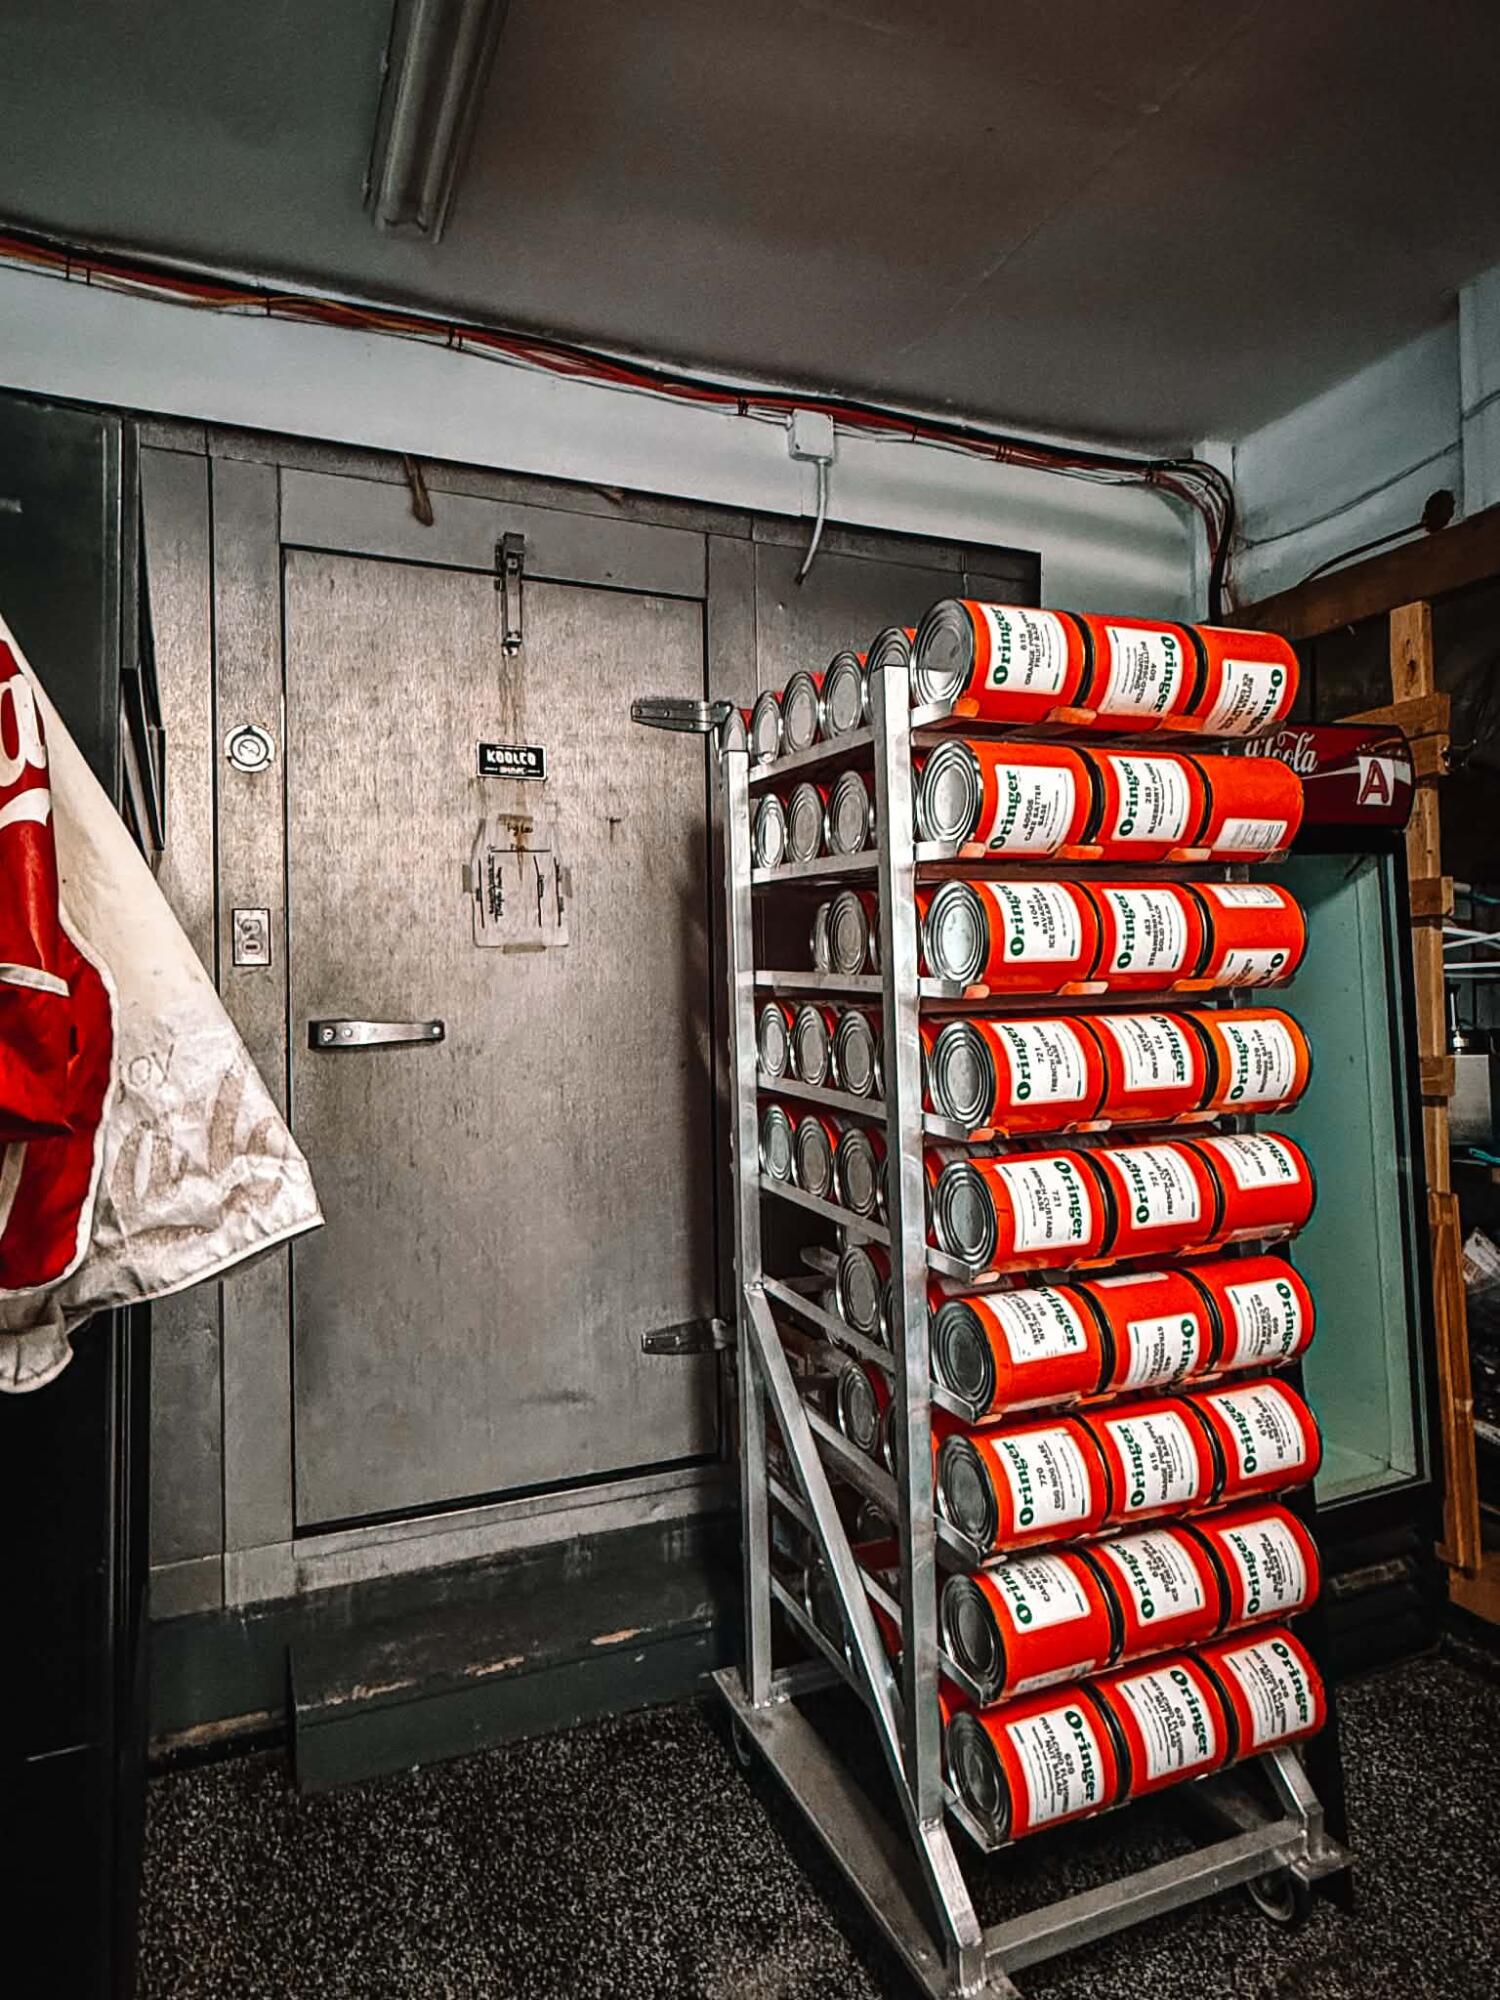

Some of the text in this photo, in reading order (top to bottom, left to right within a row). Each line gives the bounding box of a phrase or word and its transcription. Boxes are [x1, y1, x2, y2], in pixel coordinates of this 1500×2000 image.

[991, 607, 1012, 685] Oringer
[1135, 641, 1150, 703] BUTTERSCOTCH
[1154, 636, 1177, 712] Oringer
[990, 771, 1022, 849] Oringer
[1119, 759, 1140, 836] Oringer
[1359, 759, 1390, 804] A
[996, 884, 1025, 956] Oringer
[1114, 892, 1136, 969] Oringer
[1002, 1025, 1031, 1100] Oringer
[1050, 1060, 1058, 1092] FRENCH
[1228, 1027, 1249, 1100] Oringer
[1034, 1190, 1045, 1212] BASE
[1053, 1161, 1082, 1238] Oringer
[1114, 1152, 1150, 1224] Oringer
[1117, 1425, 1146, 1507] Oringer
[1165, 1461, 1174, 1483] FRUIT
[1219, 1398, 1257, 1473] Oringer
[1003, 1441, 1034, 1526] Oringer
[1036, 1467, 1048, 1488] 720
[1109, 1543, 1155, 1619] Oringer
[1230, 1533, 1260, 1614] Oringer
[1147, 1676, 1175, 1721] PISTACHIO
[1169, 1670, 1207, 1756] Oringer
[1174, 1707, 1186, 1727] 620
[1271, 1642, 1308, 1723] Oringer
[1039, 1717, 1064, 1770] PISTACHIO
[1064, 1710, 1095, 1801] Oringer
[1154, 1694, 1167, 1714] NUT
[1165, 1716, 1177, 1749] SALAD
[1044, 1740, 1063, 1796] NUT SALAD
[1064, 1753, 1074, 1775] 620
